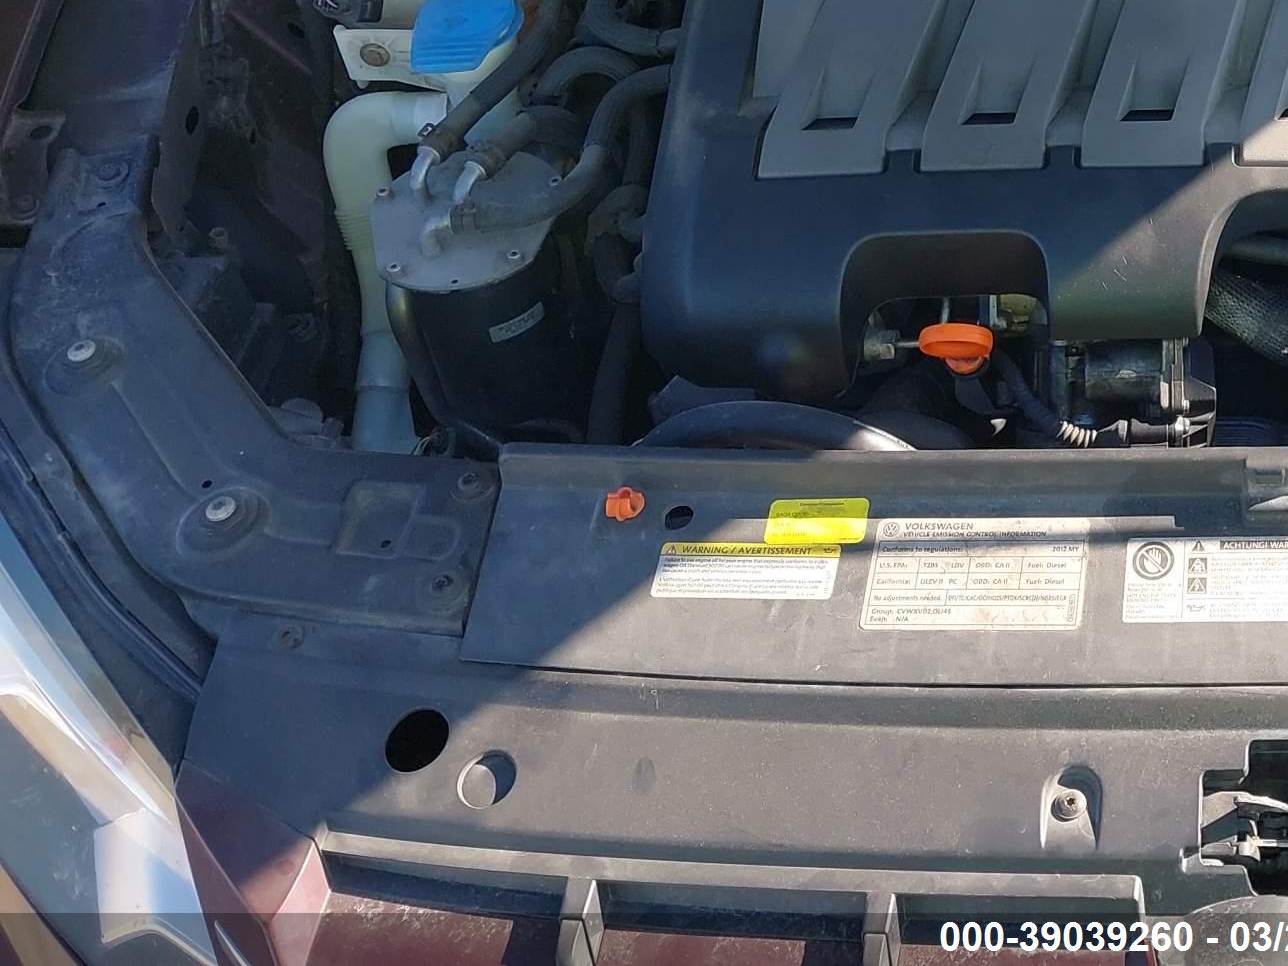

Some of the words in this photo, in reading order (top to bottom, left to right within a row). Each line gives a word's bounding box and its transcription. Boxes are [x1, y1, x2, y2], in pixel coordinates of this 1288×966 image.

[905, 522, 973, 531] VOLKSWAGEN
[1224, 541, 1267, 549] ACHTUNG!
[682, 546, 728, 554] WARNING
[739, 546, 811, 554] AVERTISSEMENT
